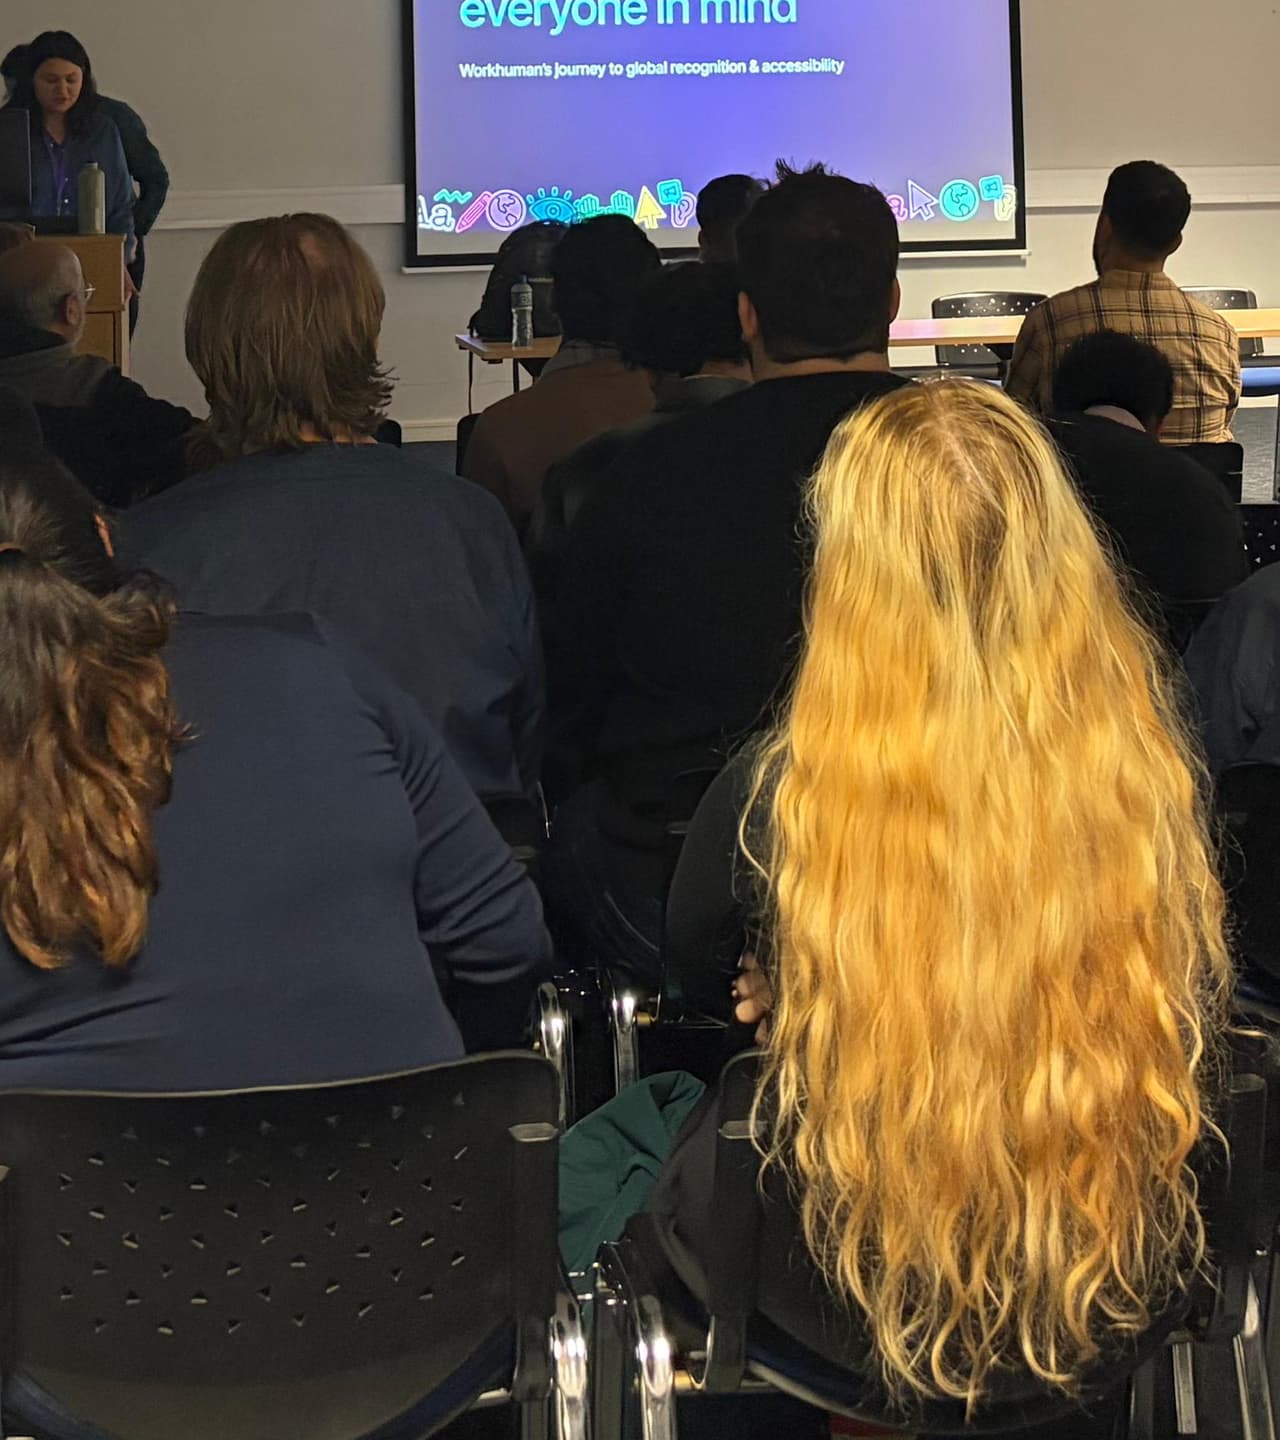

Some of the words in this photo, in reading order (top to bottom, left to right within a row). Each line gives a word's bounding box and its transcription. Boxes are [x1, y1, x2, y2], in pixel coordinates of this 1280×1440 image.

[459, 62, 552, 78] Workhuman's
[553, 62, 606, 79] journey
[609, 62, 623, 76] to
[626, 61, 667, 79] global
[670, 60, 747, 77] recognition
[749, 60, 760, 74] &
[762, 58, 844, 76] accessibility
